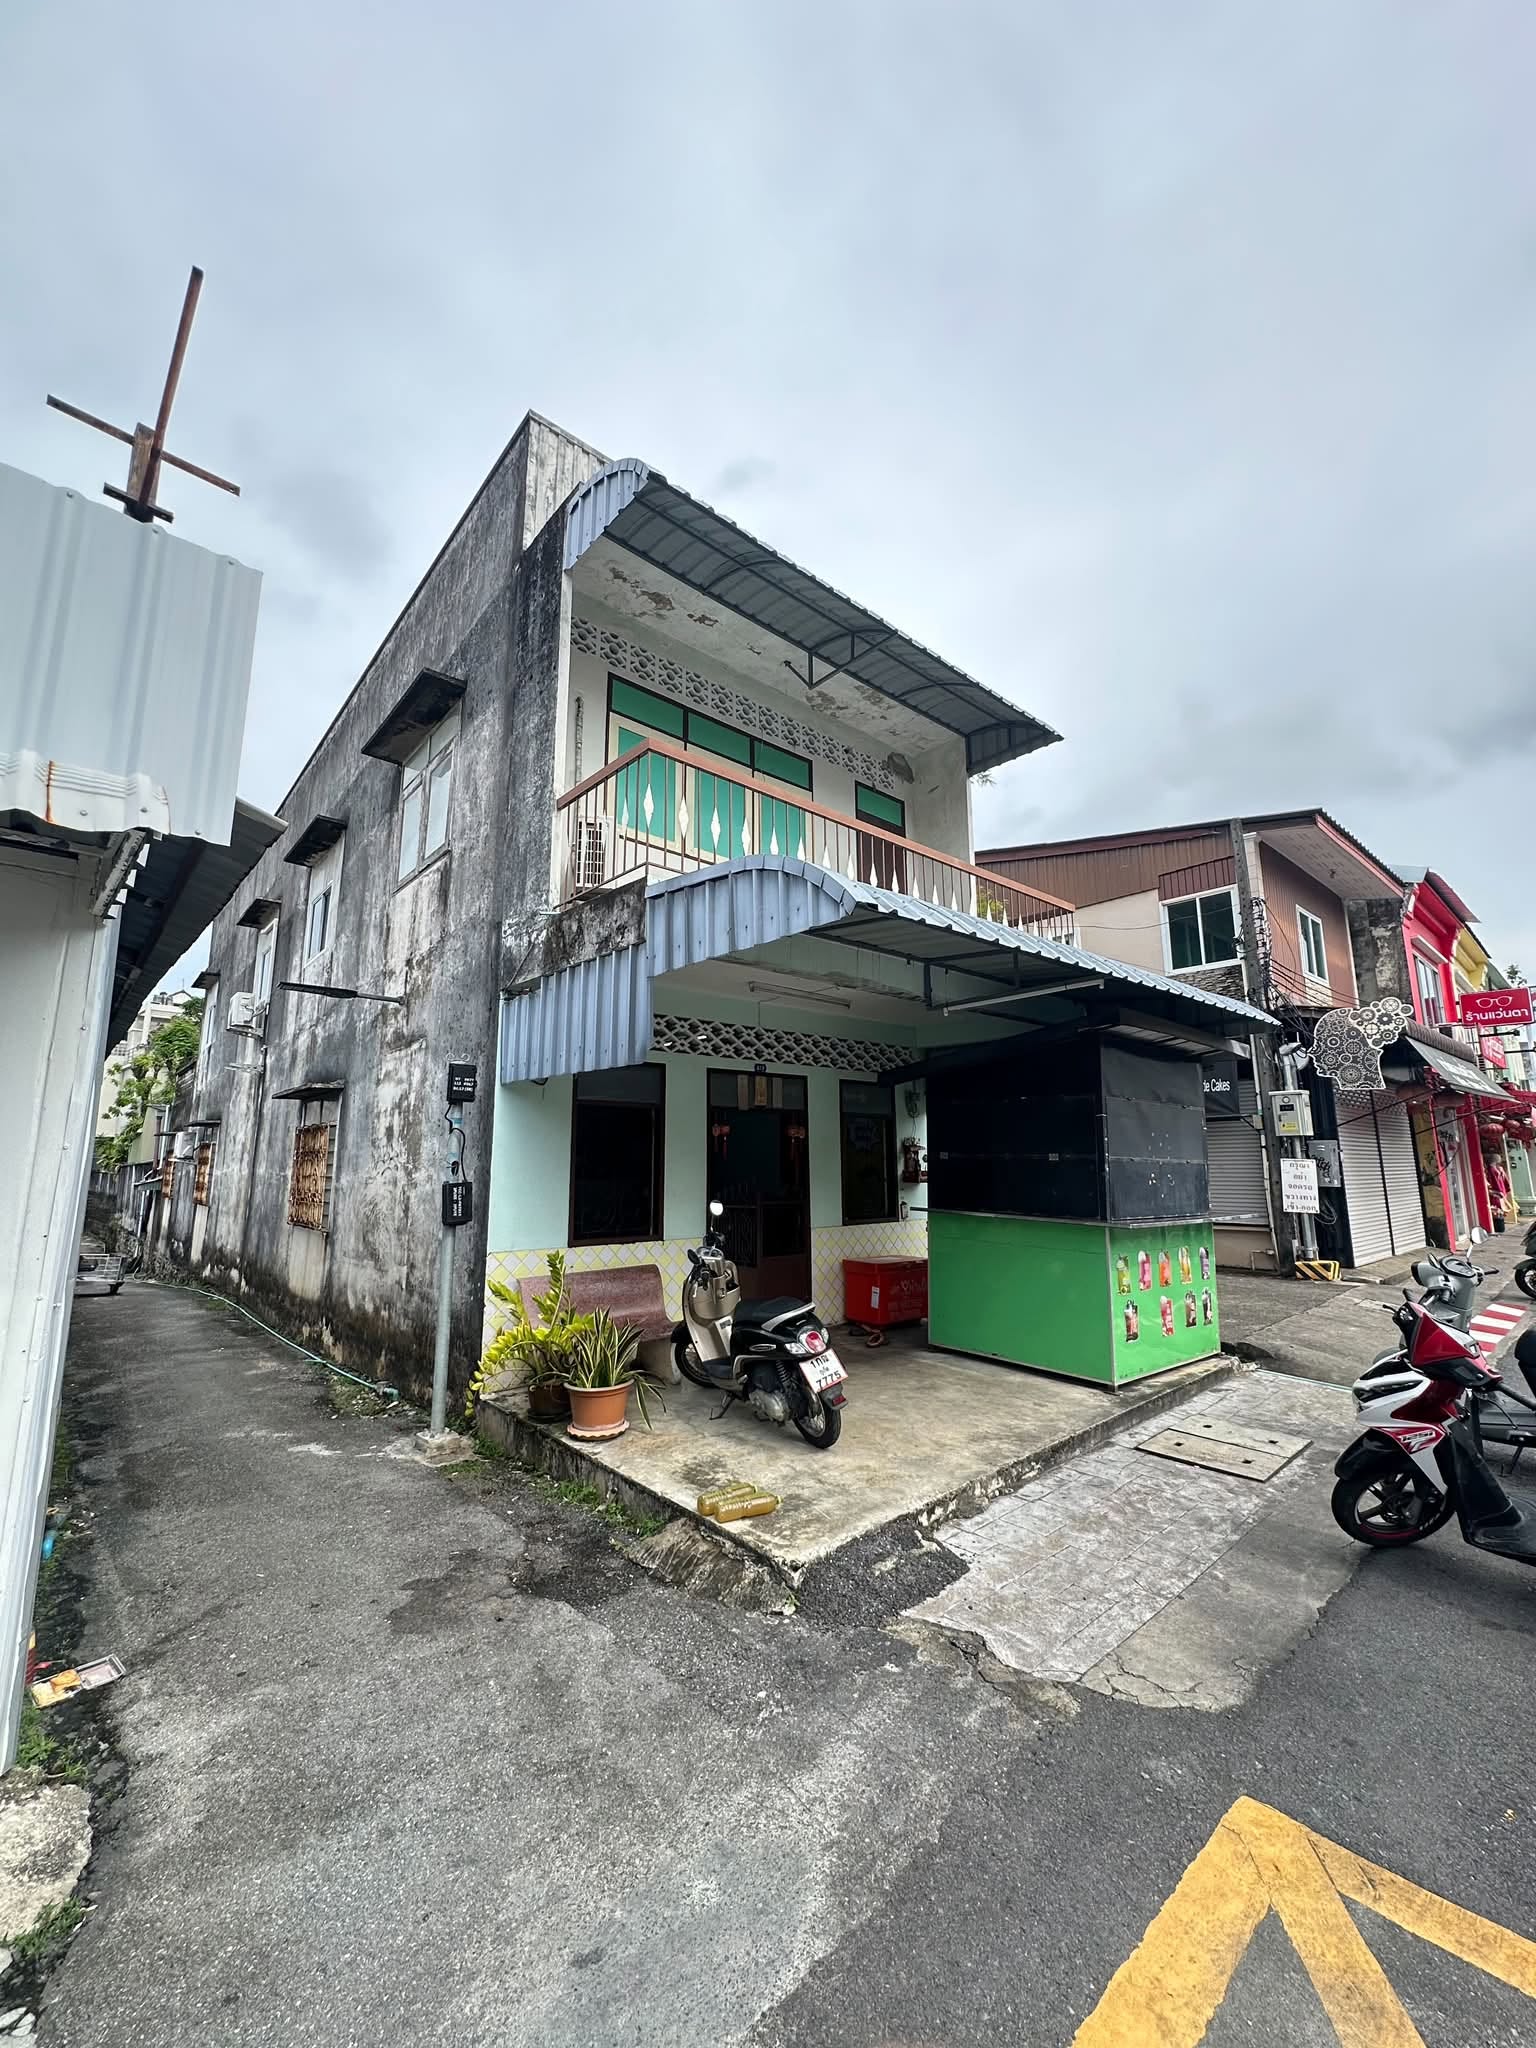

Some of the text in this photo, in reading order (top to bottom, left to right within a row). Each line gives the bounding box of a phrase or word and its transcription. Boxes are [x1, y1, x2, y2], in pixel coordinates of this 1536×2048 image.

[1465, 1008, 1529, 1021] ร้านแว่นตา
[1211, 1078, 1231, 1092] Cakes
[816, 1370, 841, 1388] 7775
